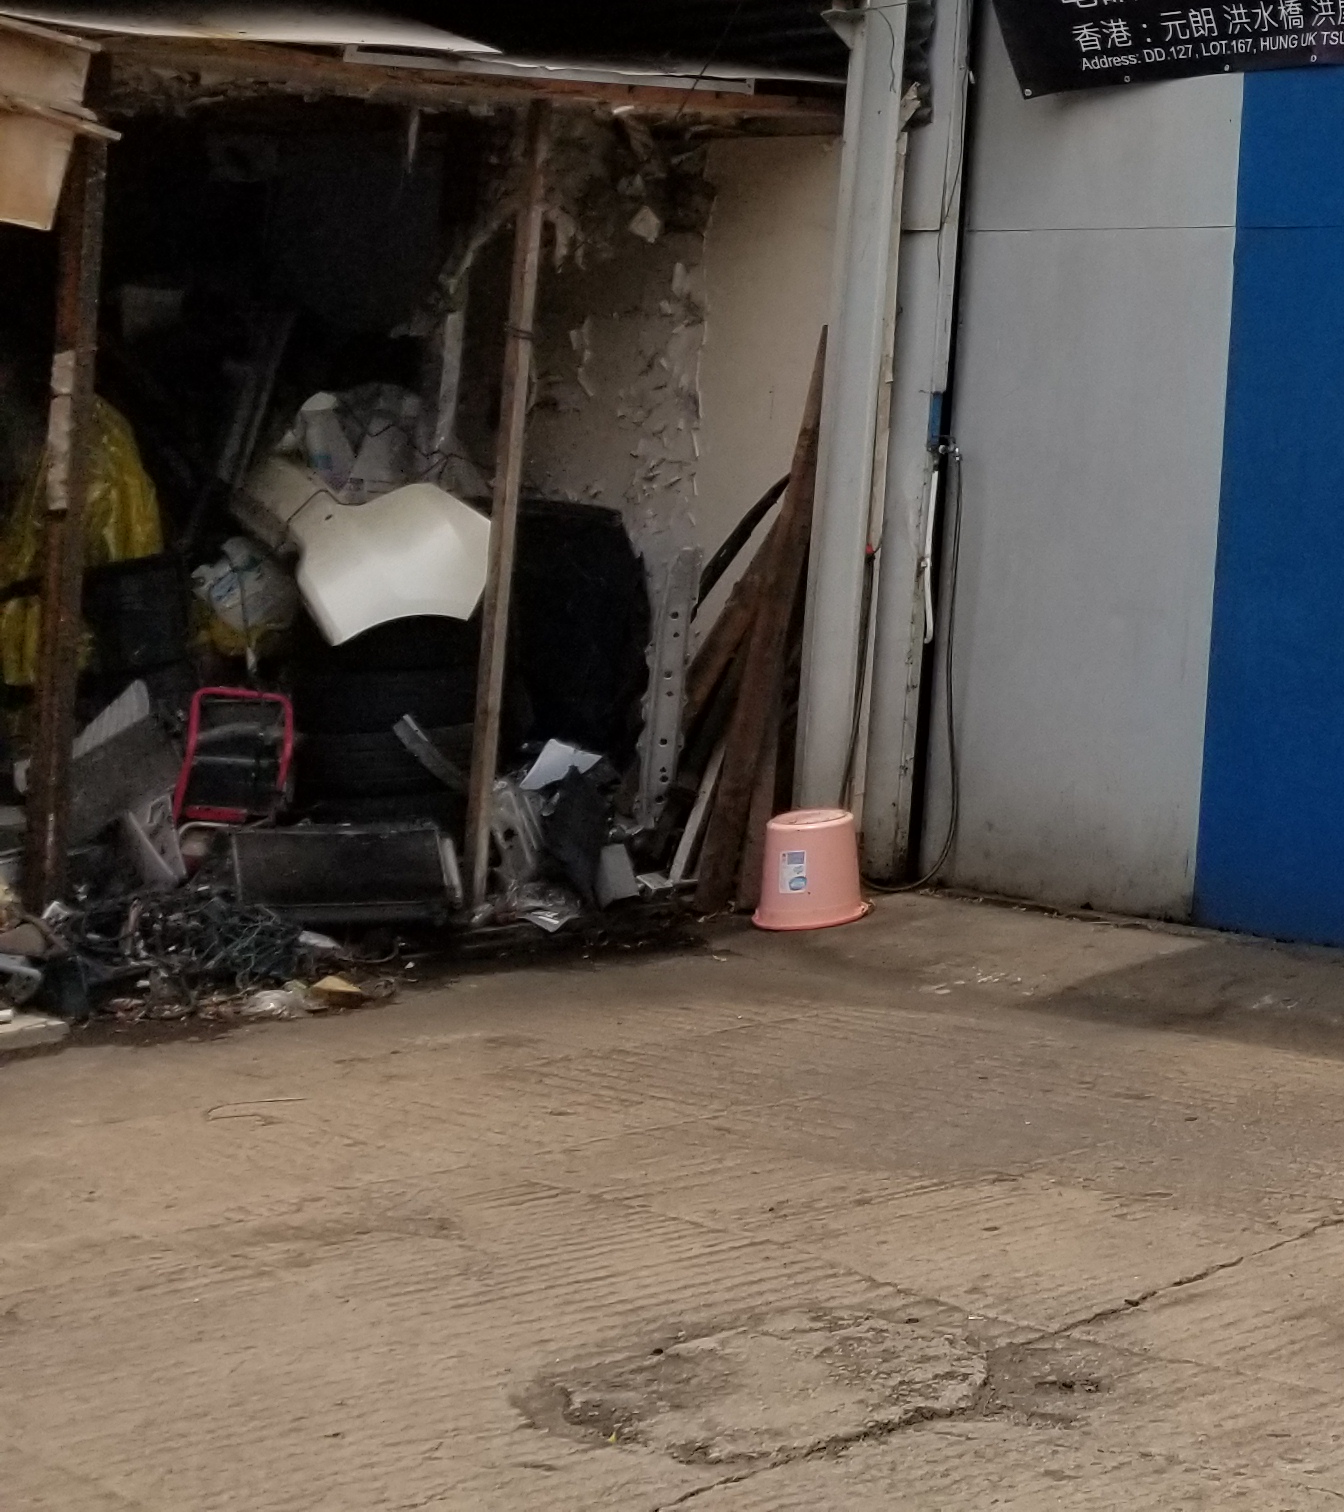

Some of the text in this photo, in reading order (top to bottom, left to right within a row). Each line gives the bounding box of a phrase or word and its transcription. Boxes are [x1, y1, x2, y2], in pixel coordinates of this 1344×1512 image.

[1160, 7, 1218, 41] 元朗
[1082, 52, 1141, 70] Address:
[1260, 34, 1298, 51] HUNG
